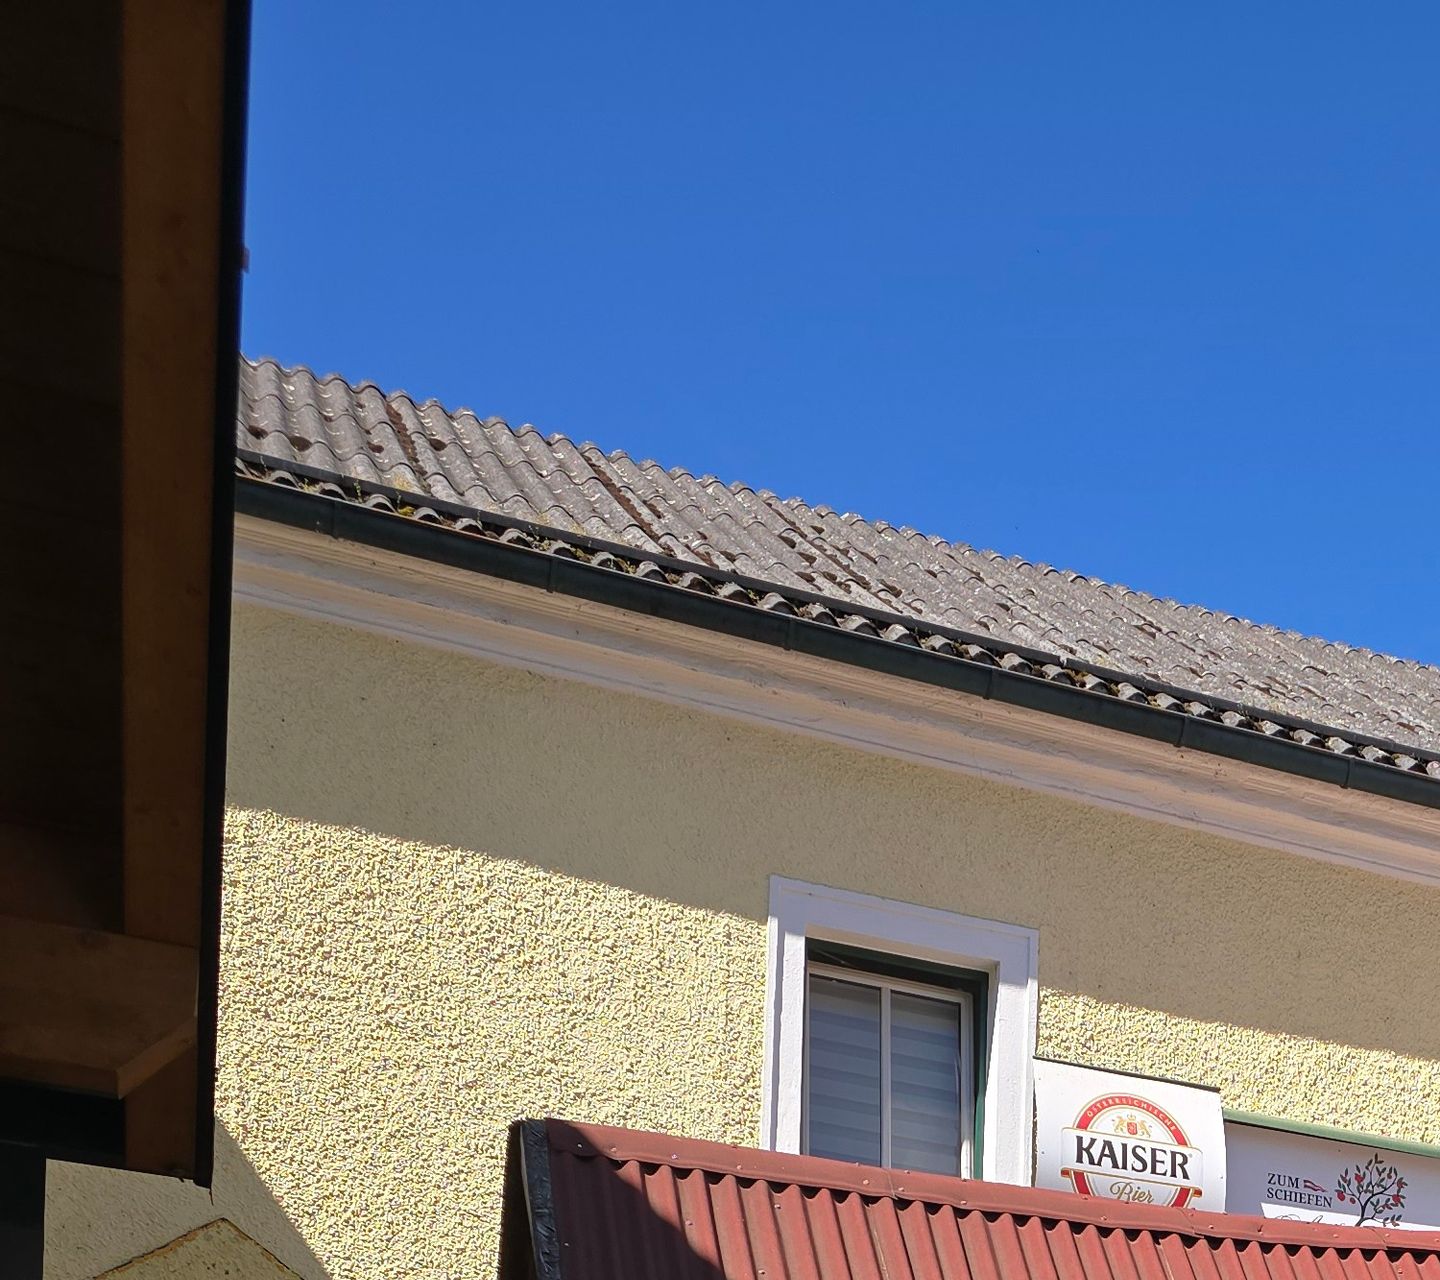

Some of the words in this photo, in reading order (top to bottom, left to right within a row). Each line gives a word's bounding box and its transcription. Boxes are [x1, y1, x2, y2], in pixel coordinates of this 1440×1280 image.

[1075, 1135, 1191, 1180] KAISER
[1267, 1172, 1299, 1189] ZUM
[1109, 1181, 1154, 1204] Bier
[1266, 1187, 1333, 1209] SCHIEFEN
